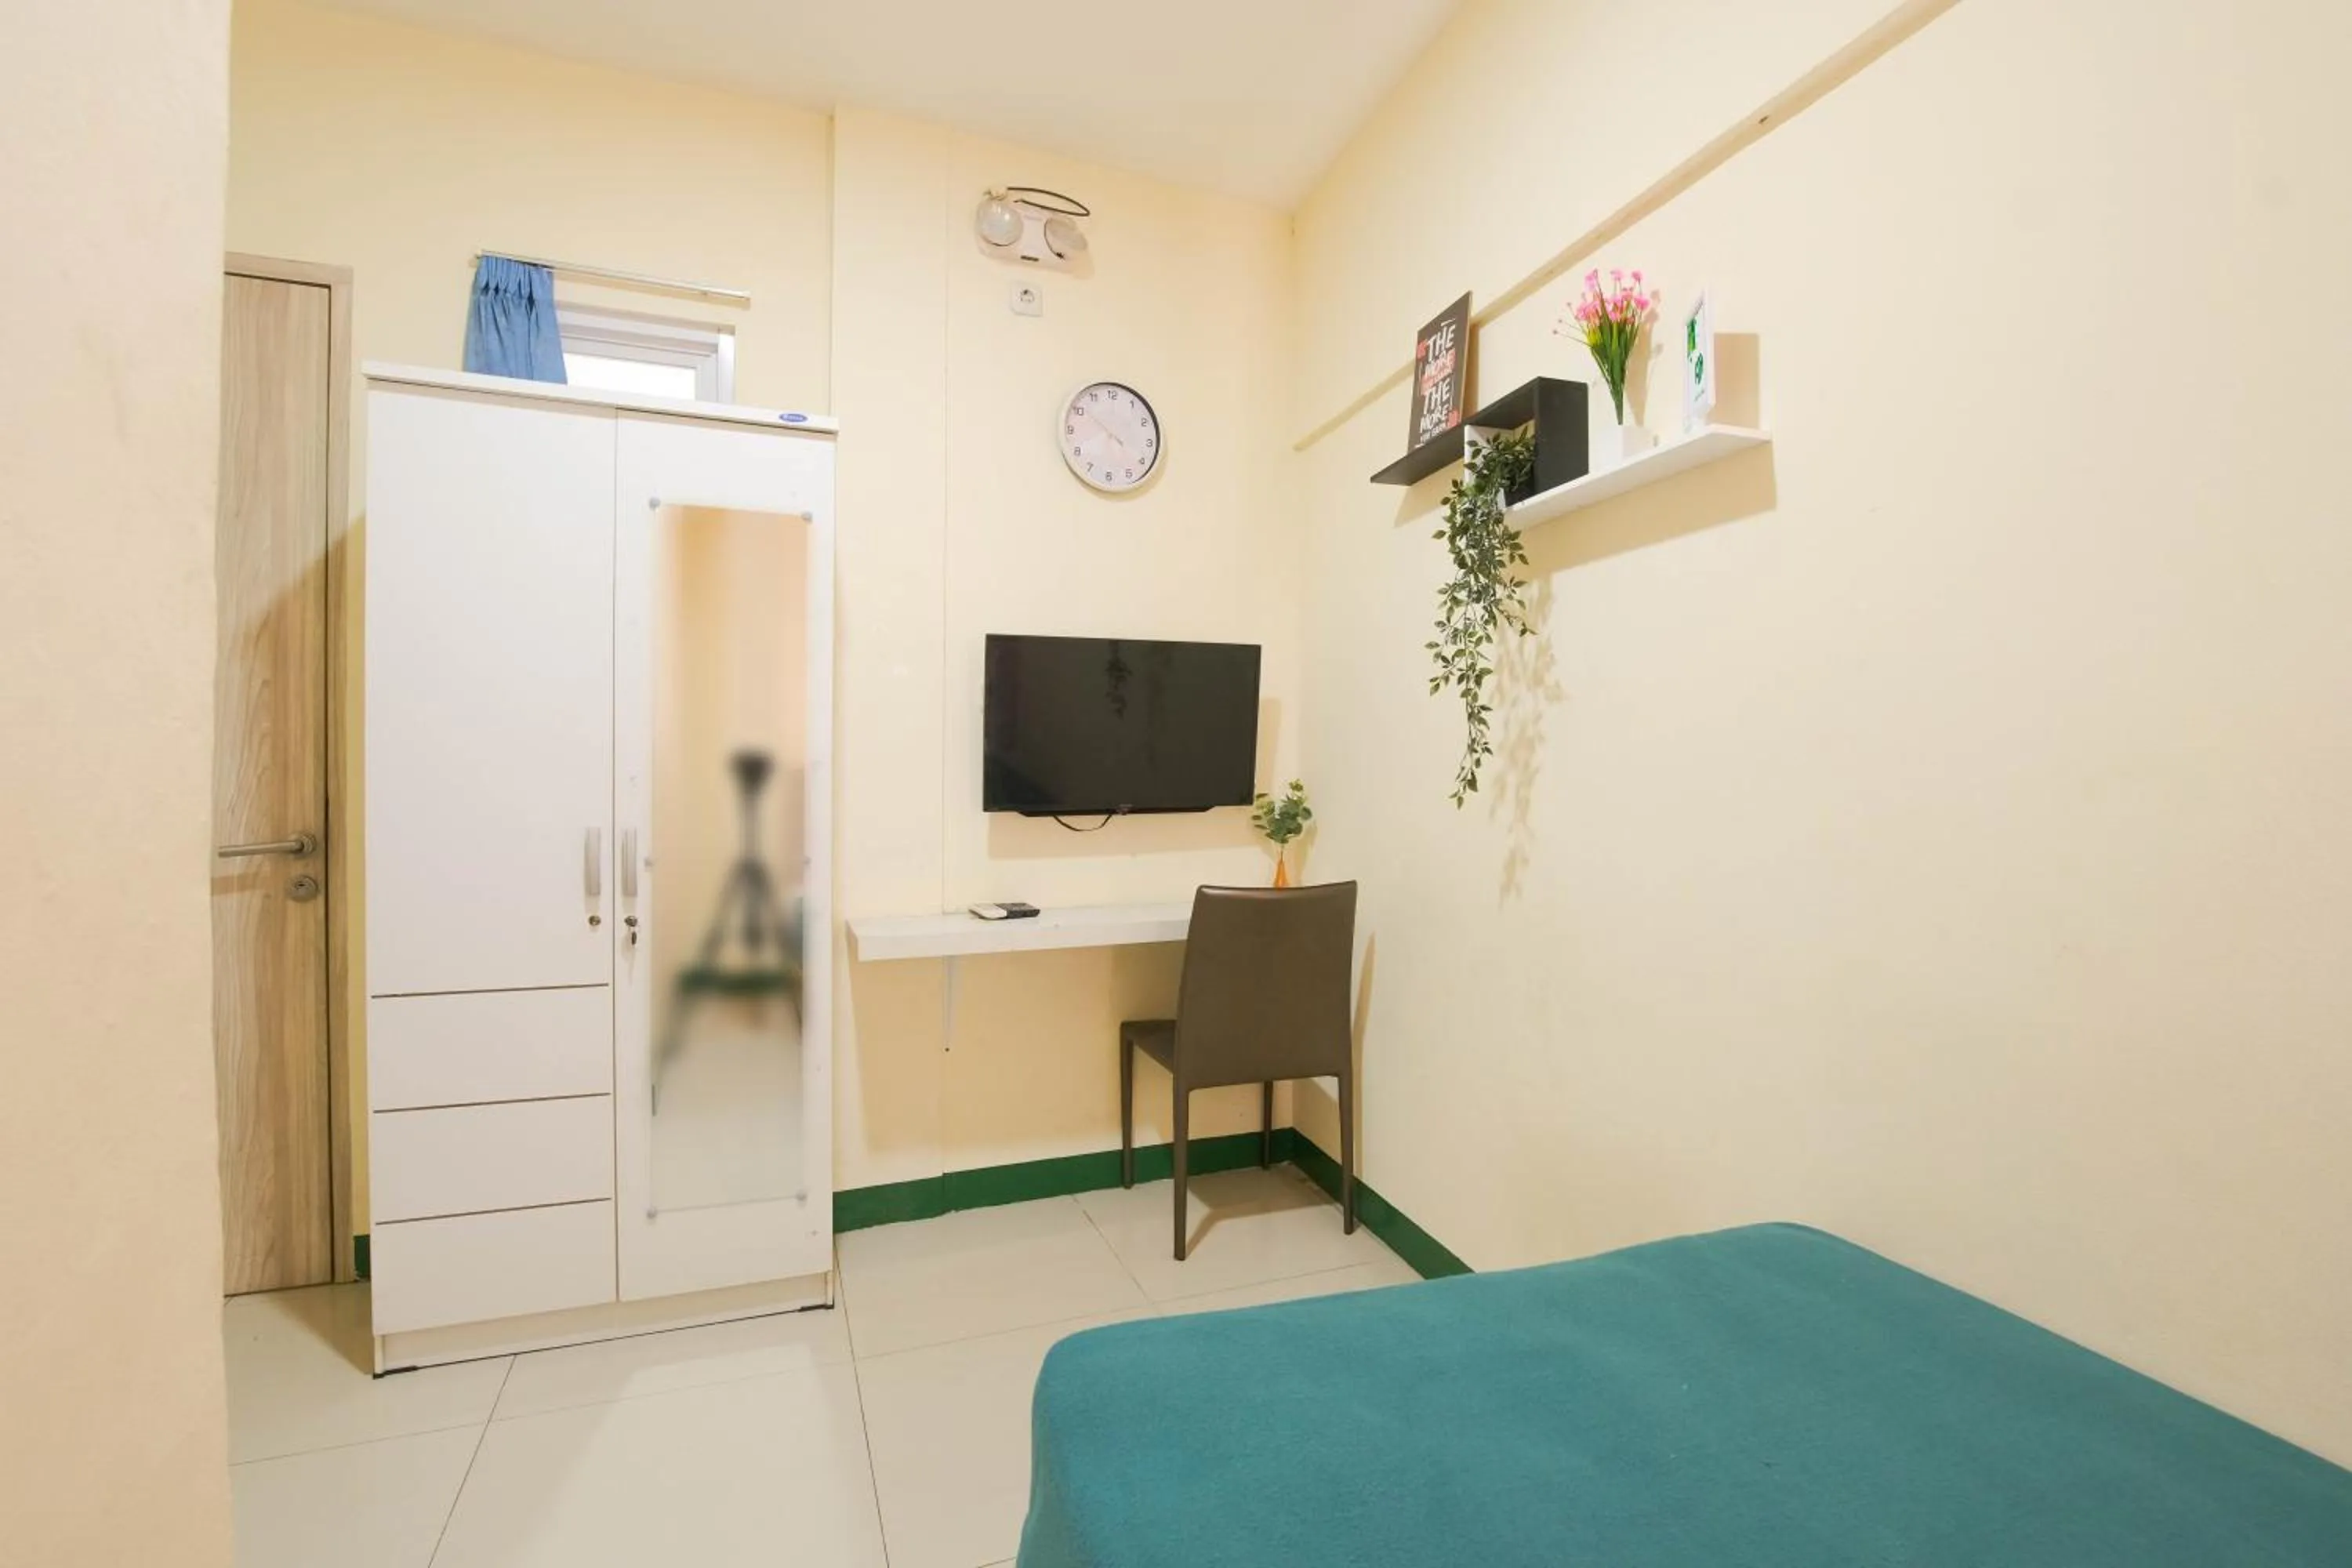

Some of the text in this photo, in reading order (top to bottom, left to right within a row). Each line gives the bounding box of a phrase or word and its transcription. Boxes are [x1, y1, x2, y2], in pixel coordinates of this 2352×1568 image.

[1426, 325, 1456, 361] THE
[1089, 393, 1098, 401] 11
[1107, 390, 1118, 400] 12
[1423, 378, 1450, 415] THE
[1129, 400, 1134, 408] 1
[1073, 406, 1084, 416] 10
[1141, 417, 1149, 427] 2
[1420, 404, 1449, 433] MORE
[1067, 425, 1074, 434] 9
[1145, 438, 1153, 448] 3
[1073, 446, 1081, 456] 8
[1087, 462, 1094, 472] 7
[1105, 471, 1112, 481] 6
[1125, 469, 1133, 478] 5
